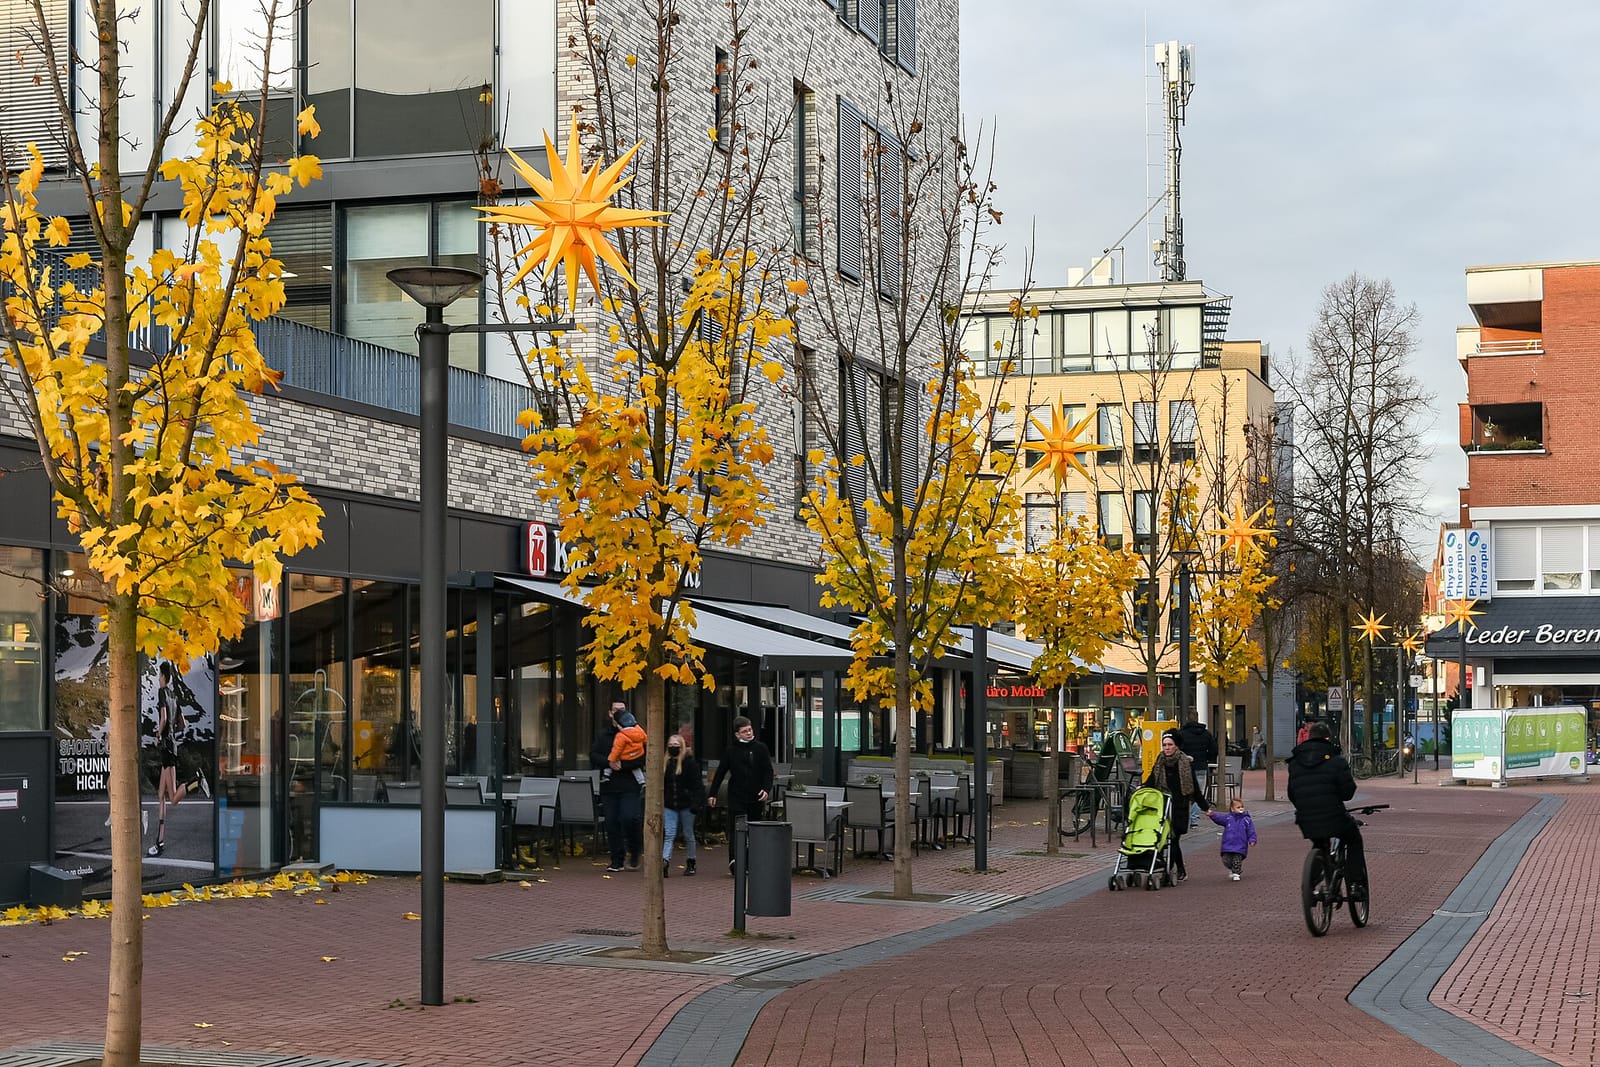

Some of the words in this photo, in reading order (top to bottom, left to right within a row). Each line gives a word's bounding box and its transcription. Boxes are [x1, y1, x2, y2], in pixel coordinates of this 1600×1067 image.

[1446, 555, 1455, 597] Physio
[1456, 543, 1464, 595] Therapie
[1468, 555, 1478, 597] Physio
[1479, 543, 1489, 596] Therapie
[1465, 625, 1530, 644] Leder
[1535, 624, 1600, 644] Beren
[1011, 685, 1046, 697] Mohr
[1103, 683, 1164, 697] DERPAT
[59, 739, 110, 756] SHORTCU
[59, 757, 76, 774] TO
[76, 774, 106, 791] HIGH.
